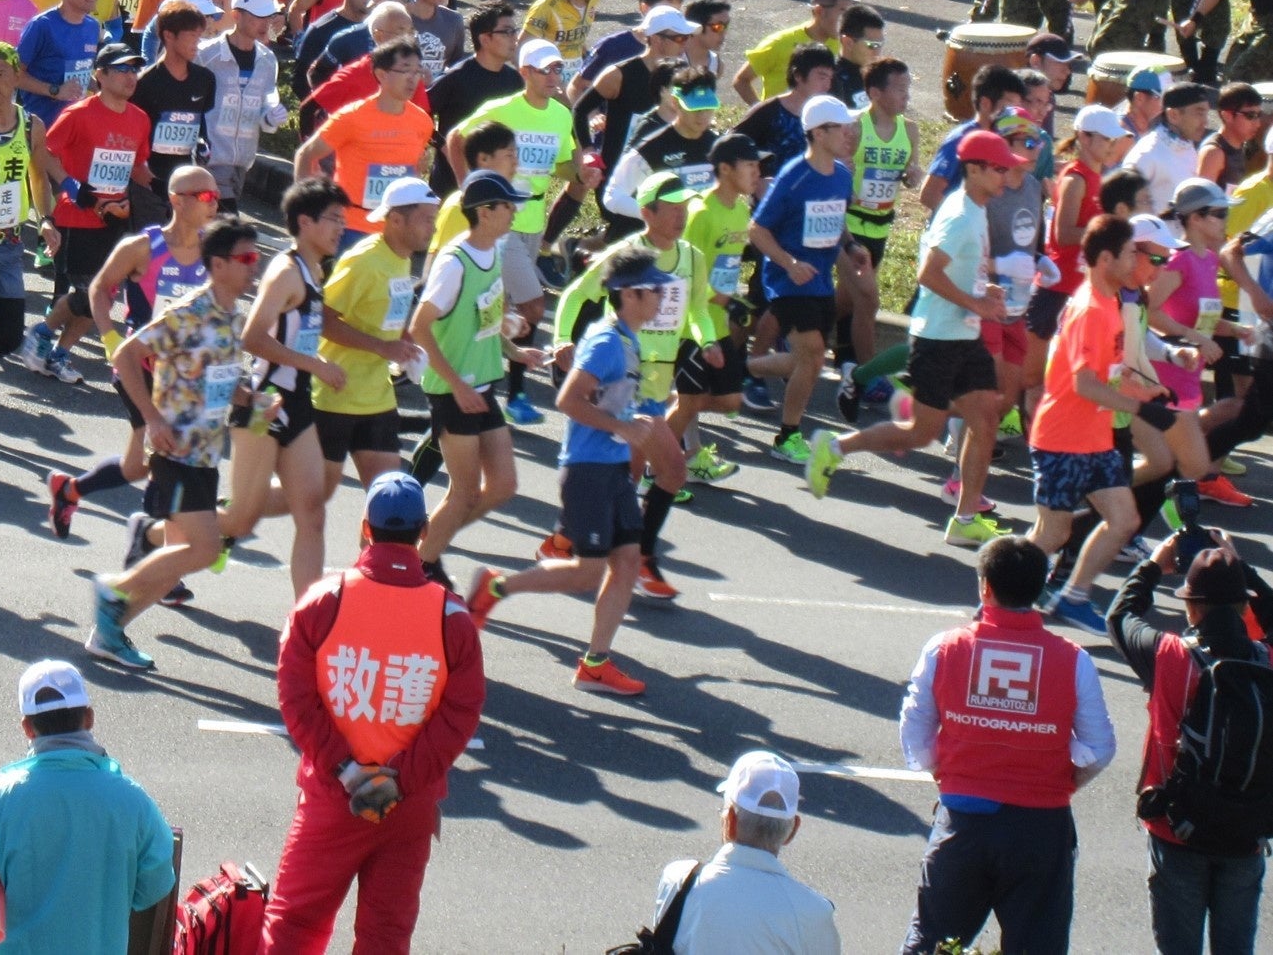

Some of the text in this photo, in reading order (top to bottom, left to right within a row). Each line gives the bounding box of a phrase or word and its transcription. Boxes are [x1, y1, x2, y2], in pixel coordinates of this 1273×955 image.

[169, 112, 194, 124] Step
[157, 125, 192, 142] 10397
[520, 134, 556, 145] GUNZE
[100, 151, 132, 163] GUNZE
[92, 163, 125, 181] 10500
[380, 165, 407, 177] Step
[866, 182, 894, 198] 336
[327, 643, 440, 727] 救護
[969, 694, 1035, 713] RUNPHOTO2.0
[945, 711, 1057, 735] PHOTOGRAPHER
